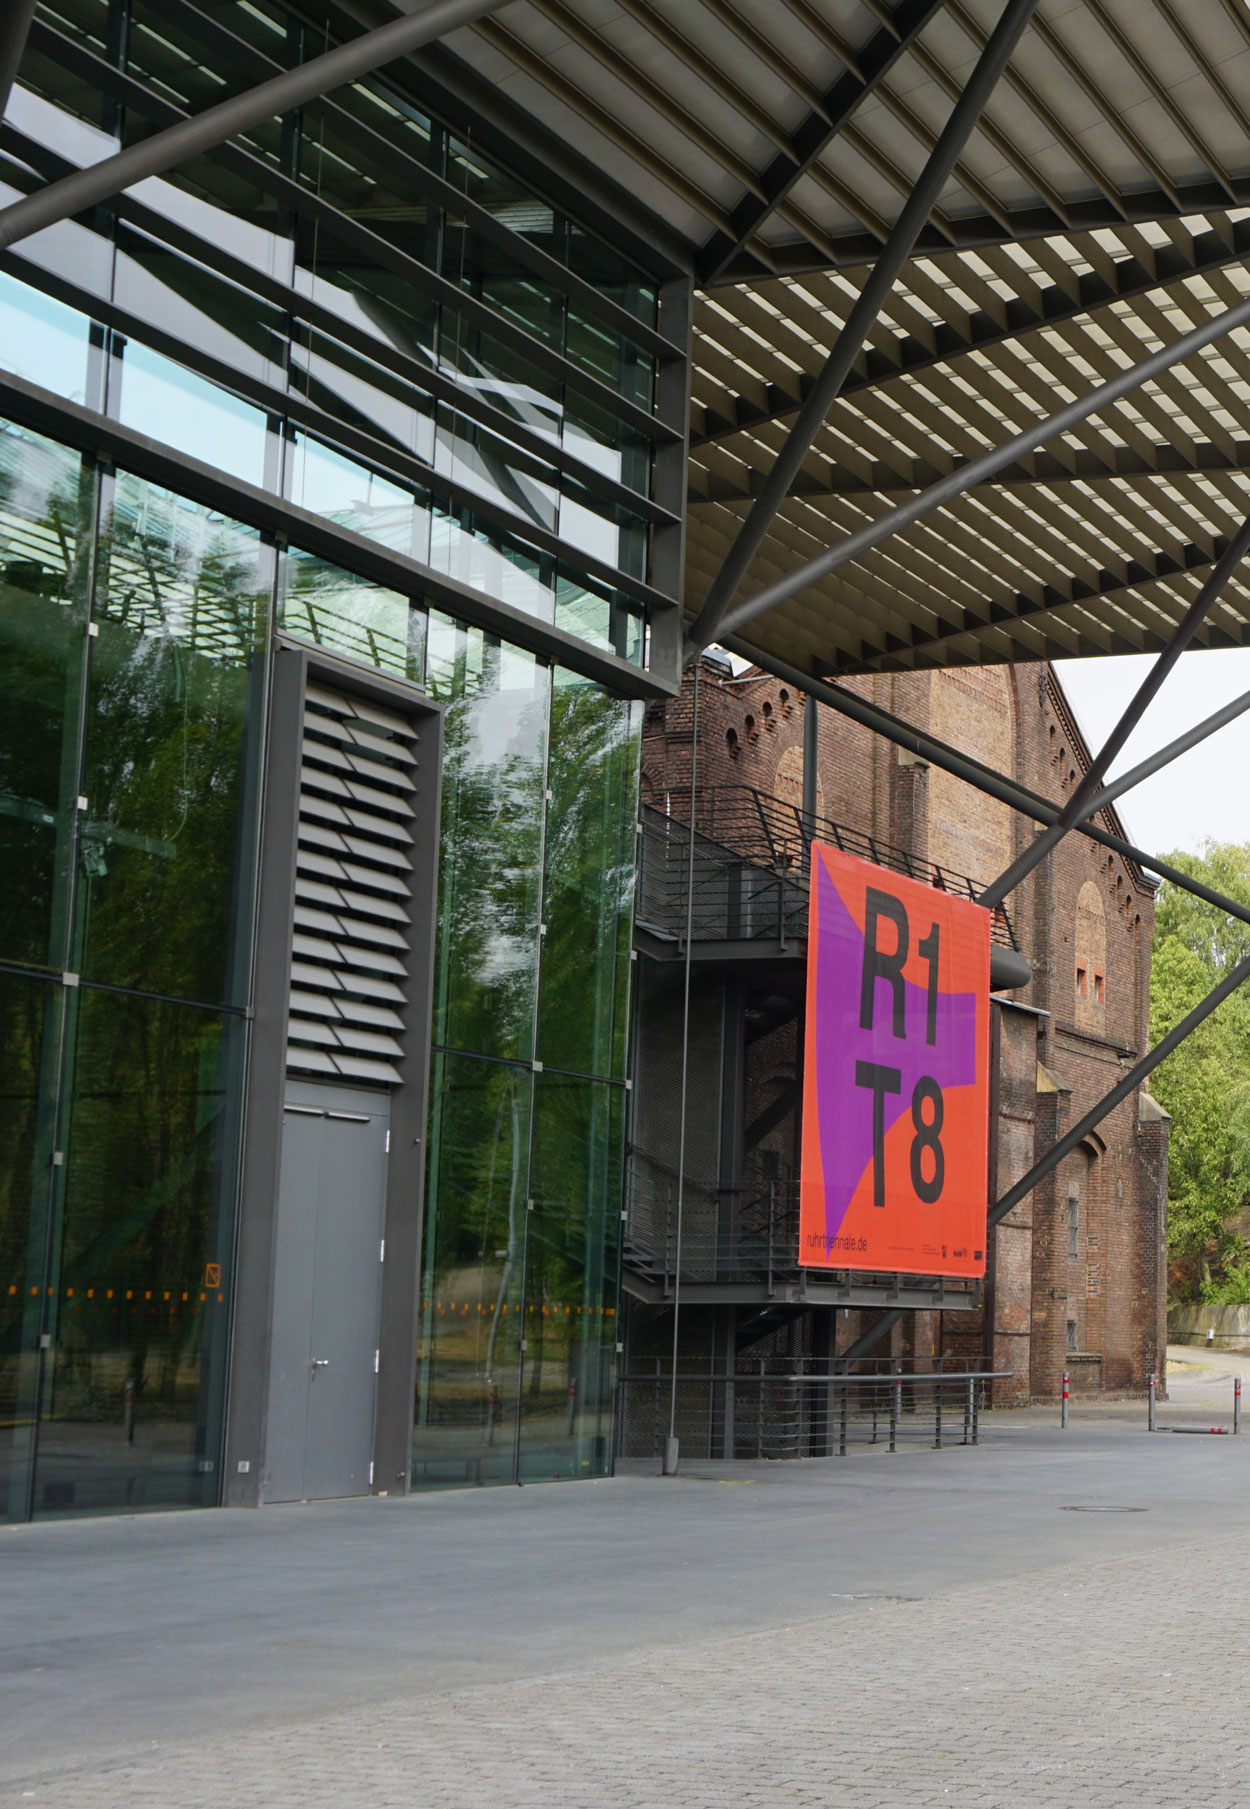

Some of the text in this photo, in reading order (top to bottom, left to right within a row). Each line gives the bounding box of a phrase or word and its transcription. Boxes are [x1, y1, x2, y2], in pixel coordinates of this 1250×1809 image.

[860, 886, 940, 1046] R1
[855, 1060, 945, 1208] T8
[806, 1232, 868, 1252] ruhrtriennale.de
